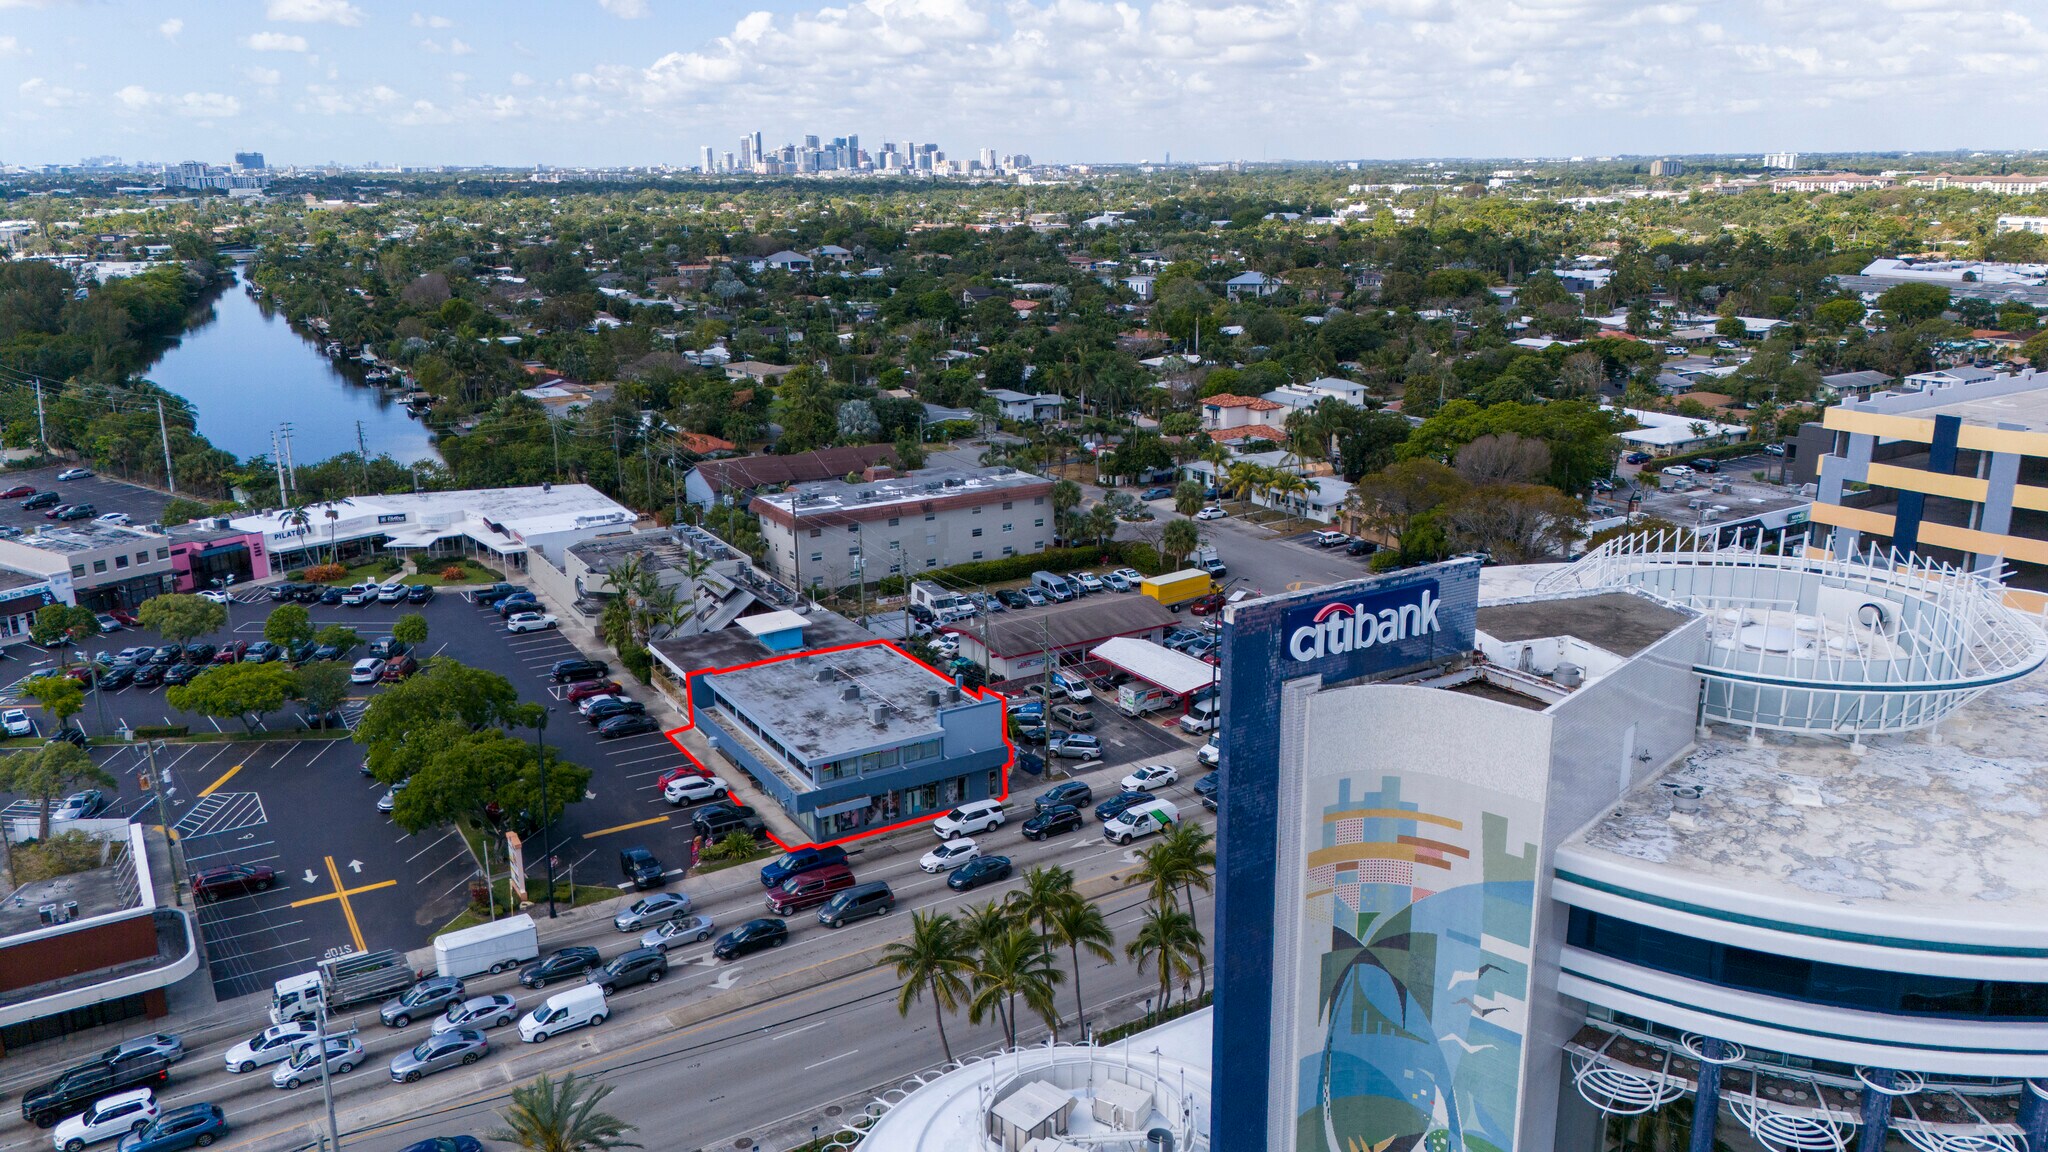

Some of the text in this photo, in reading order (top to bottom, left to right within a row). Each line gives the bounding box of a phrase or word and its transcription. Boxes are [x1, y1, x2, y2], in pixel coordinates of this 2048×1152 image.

[274, 528, 306, 540] PILATES
[1289, 589, 1441, 662] citibank
[324, 944, 353, 959] STOP
